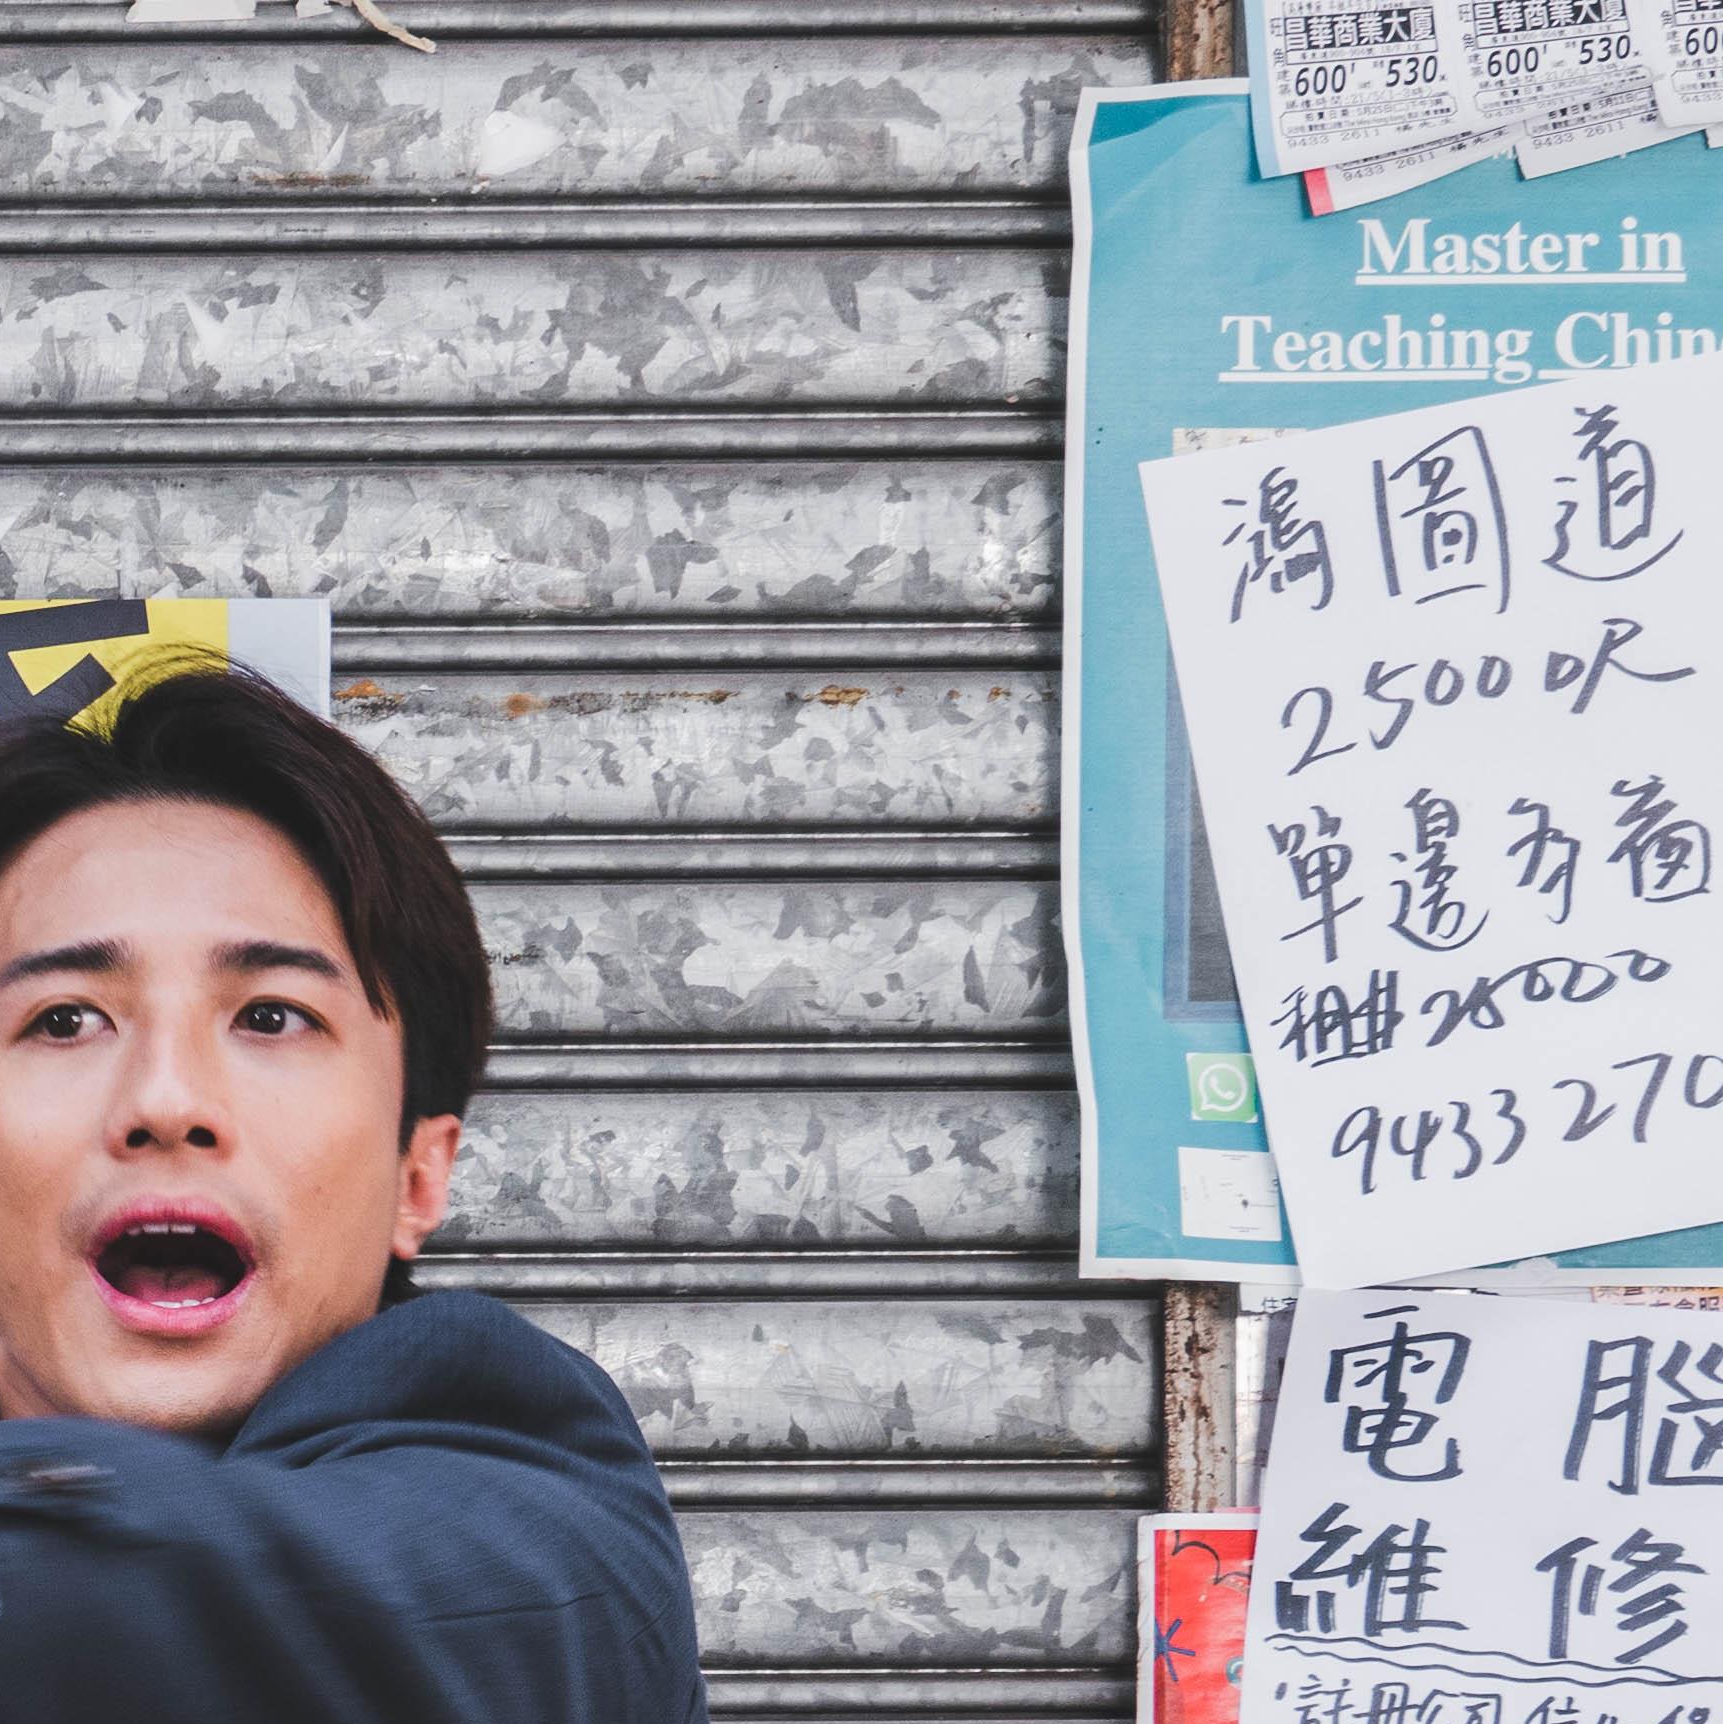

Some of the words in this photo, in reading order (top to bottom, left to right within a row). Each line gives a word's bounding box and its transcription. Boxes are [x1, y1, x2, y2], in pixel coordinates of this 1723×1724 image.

[1386, 55, 1439, 88] 530
[1579, 34, 1631, 65] 530
[1586, 120, 1626, 138] 2611
[1343, 164, 1386, 182] 9433
[1396, 151, 1436, 169] 2611
[1357, 218, 1586, 274] Master
[1621, 217, 1686, 273] in
[1219, 313, 1533, 383] Teaching
[1555, 311, 1723, 369] Chin
[1323, 1304, 1723, 1496] 電腦
[1274, 1501, 1706, 1664] 維修
